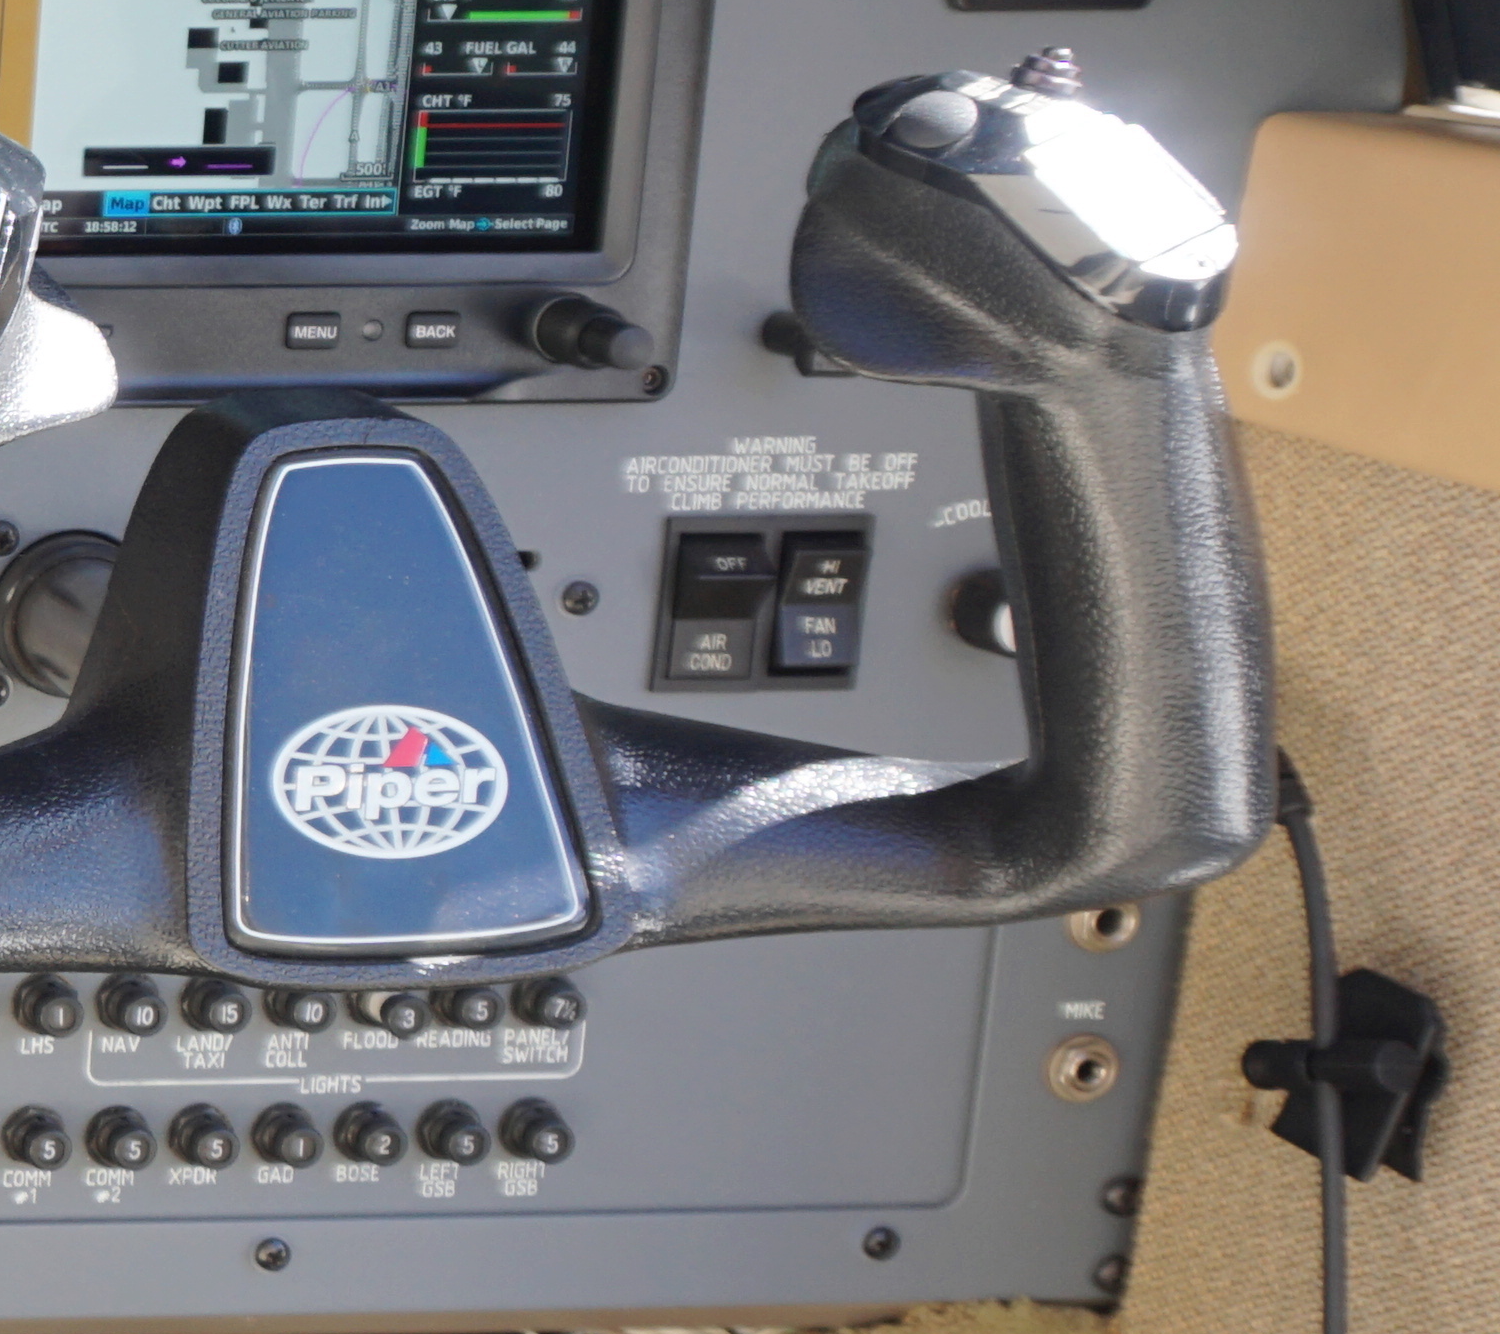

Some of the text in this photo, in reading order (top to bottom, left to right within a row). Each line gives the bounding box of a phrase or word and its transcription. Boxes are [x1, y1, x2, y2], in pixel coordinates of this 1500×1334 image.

[734, 437, 816, 454] WARNING
[627, 453, 918, 474] AIRCONDITIONER MUST BE OFF
[294, 763, 496, 820] Piper
[21, 1038, 54, 1054] LHS
[300, 1076, 361, 1094] LIGHTS
